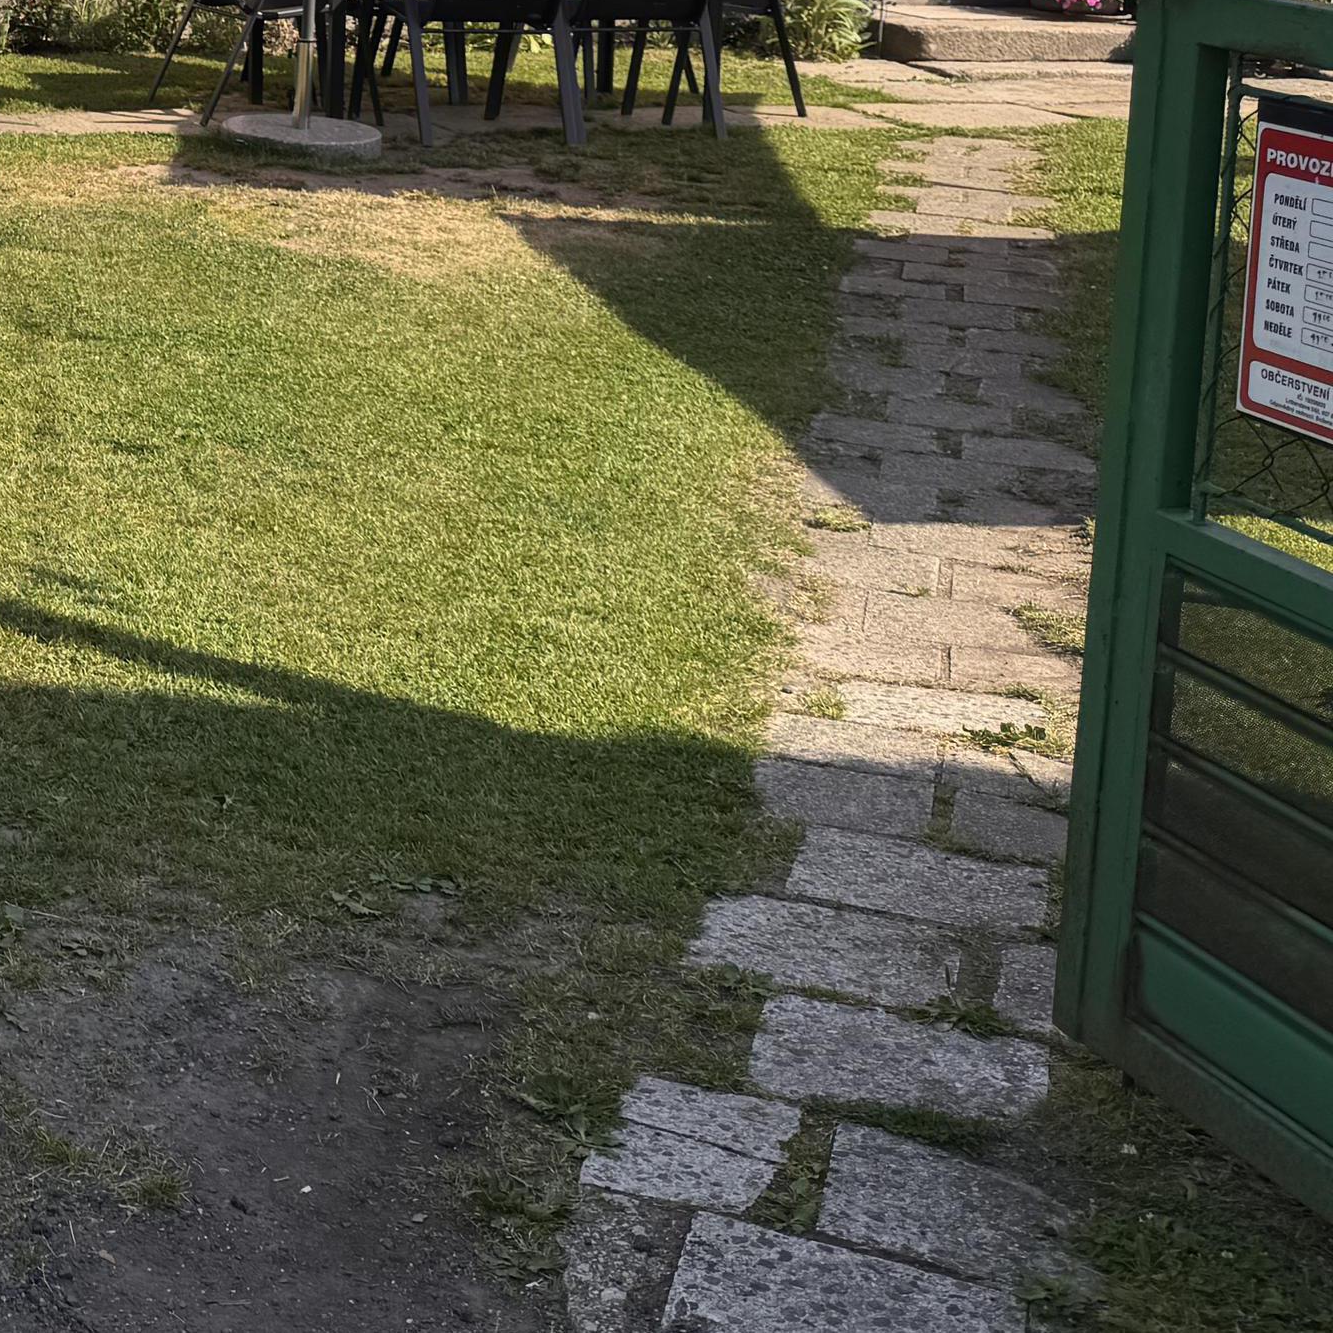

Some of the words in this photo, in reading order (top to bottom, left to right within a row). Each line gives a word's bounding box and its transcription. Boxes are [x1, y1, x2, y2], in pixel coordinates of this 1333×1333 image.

[1266, 147, 1333, 179] PROVOZ
[1274, 193, 1307, 211] PONDĚLÍ
[1272, 212, 1297, 230] ÚTERÝ
[1270, 235, 1300, 253] STŘEDA
[1268, 254, 1304, 276] ČTVRTEK
[1267, 277, 1291, 294] PÁTEK
[1265, 299, 1294, 317] SOBOTA
[1263, 320, 1292, 338] NEDĚLE
[1261, 368, 1331, 400] OBČERSTVENÍ
